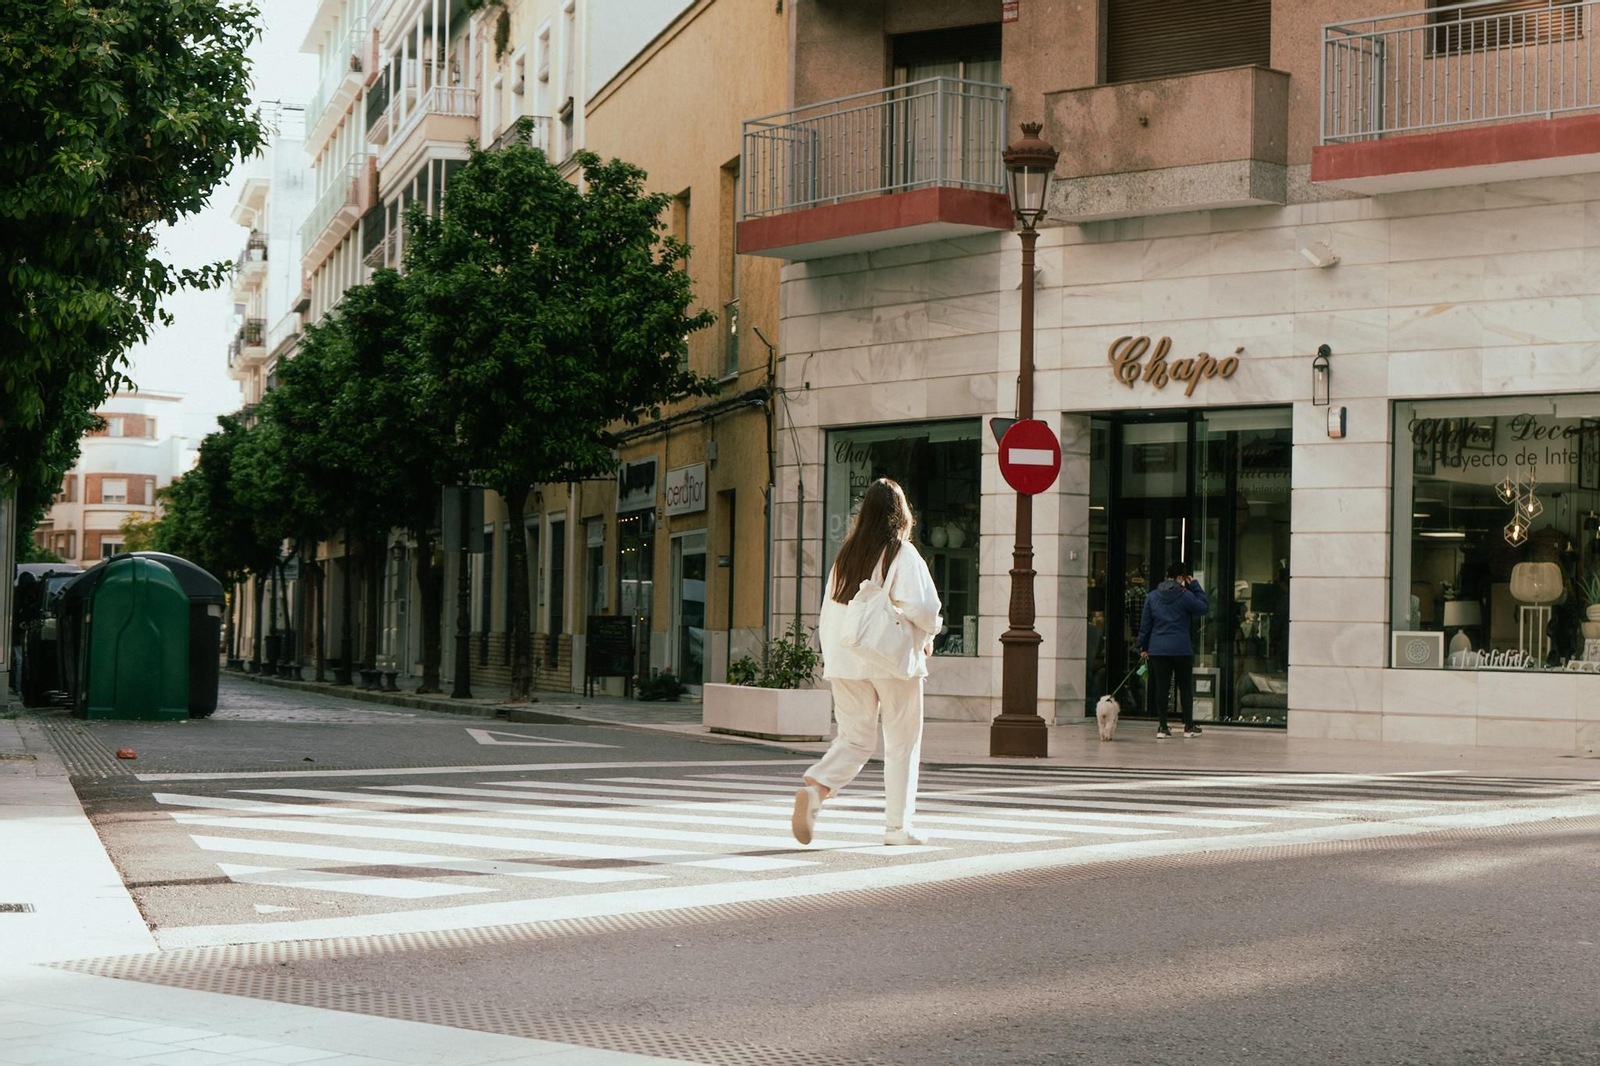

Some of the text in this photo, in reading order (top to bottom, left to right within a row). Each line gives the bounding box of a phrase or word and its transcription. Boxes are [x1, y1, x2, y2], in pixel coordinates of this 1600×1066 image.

[1108, 336, 1245, 397] Chapó
[1510, 413, 1600, 441] Deco
[1435, 450, 1508, 472] Proyecto
[1515, 446, 1537, 466] de
